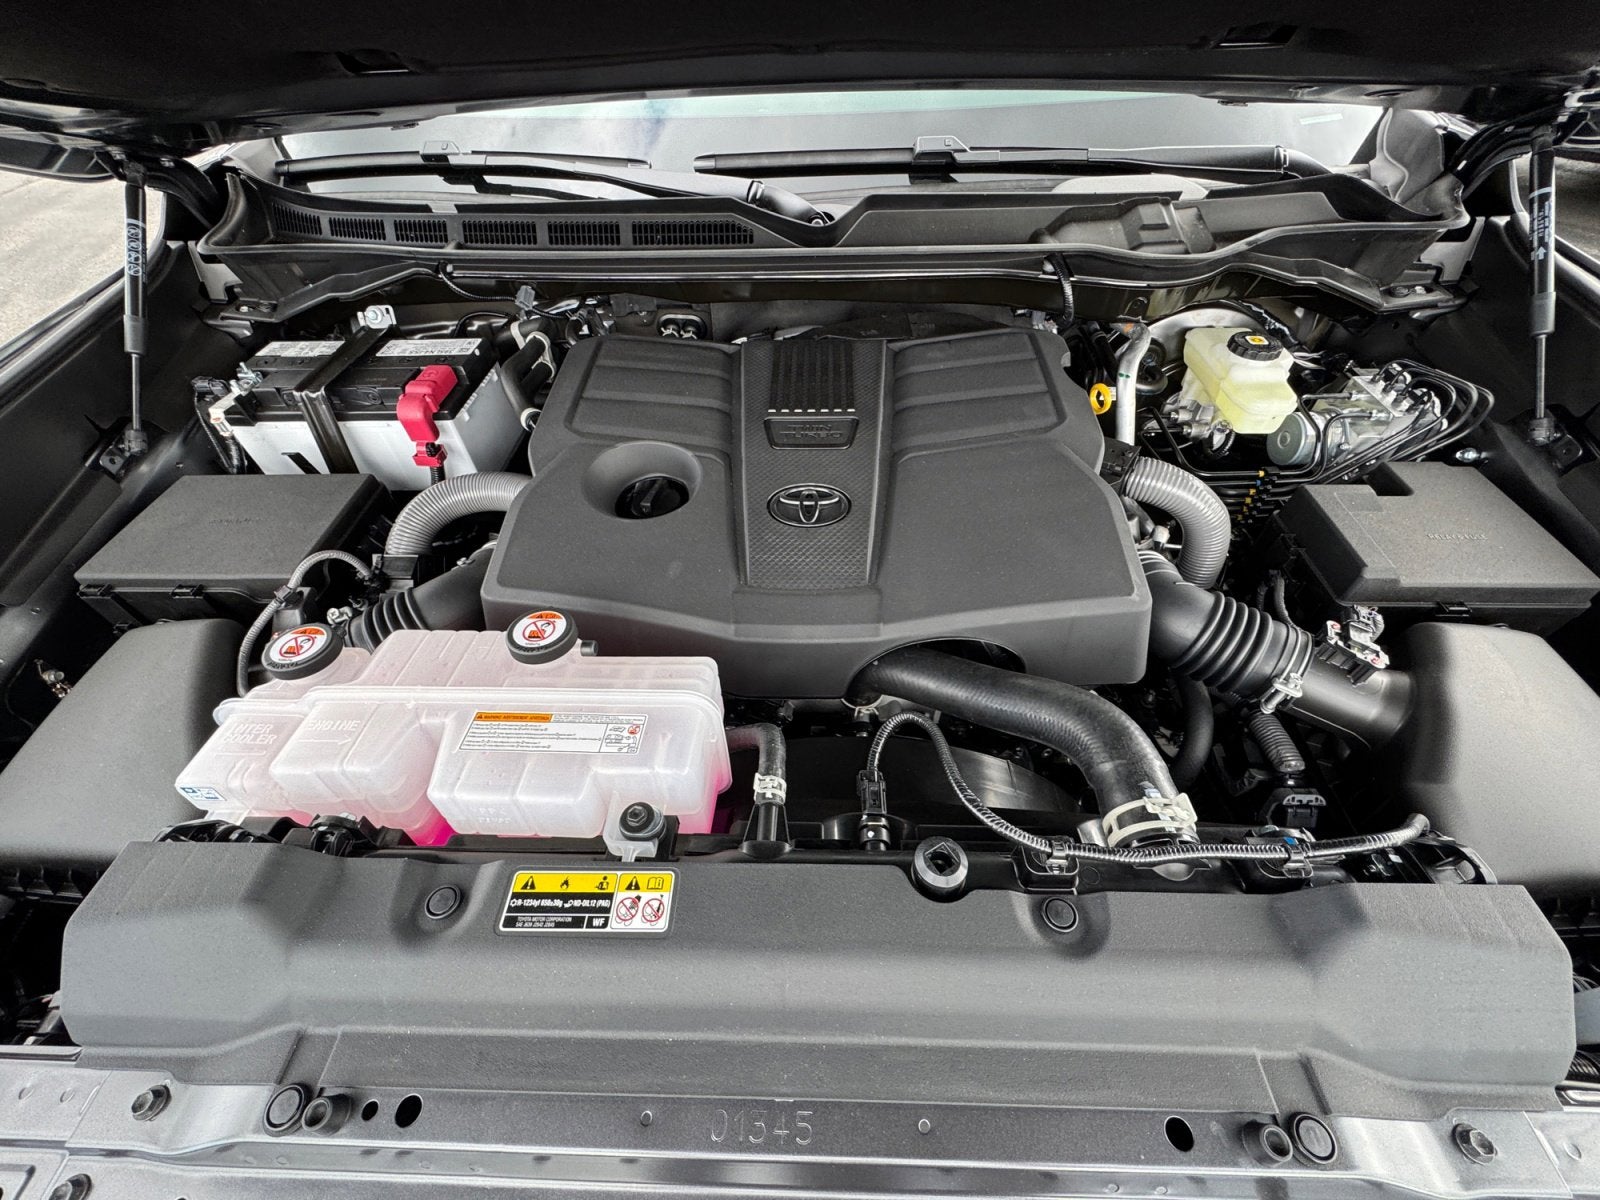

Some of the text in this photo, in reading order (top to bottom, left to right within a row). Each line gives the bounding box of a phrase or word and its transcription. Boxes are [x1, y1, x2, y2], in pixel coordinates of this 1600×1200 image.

[306, 719, 361, 731] ENGINE
[223, 734, 278, 745] COOLER
[592, 917, 606, 927] WF
[710, 1109, 814, 1146] 01345
